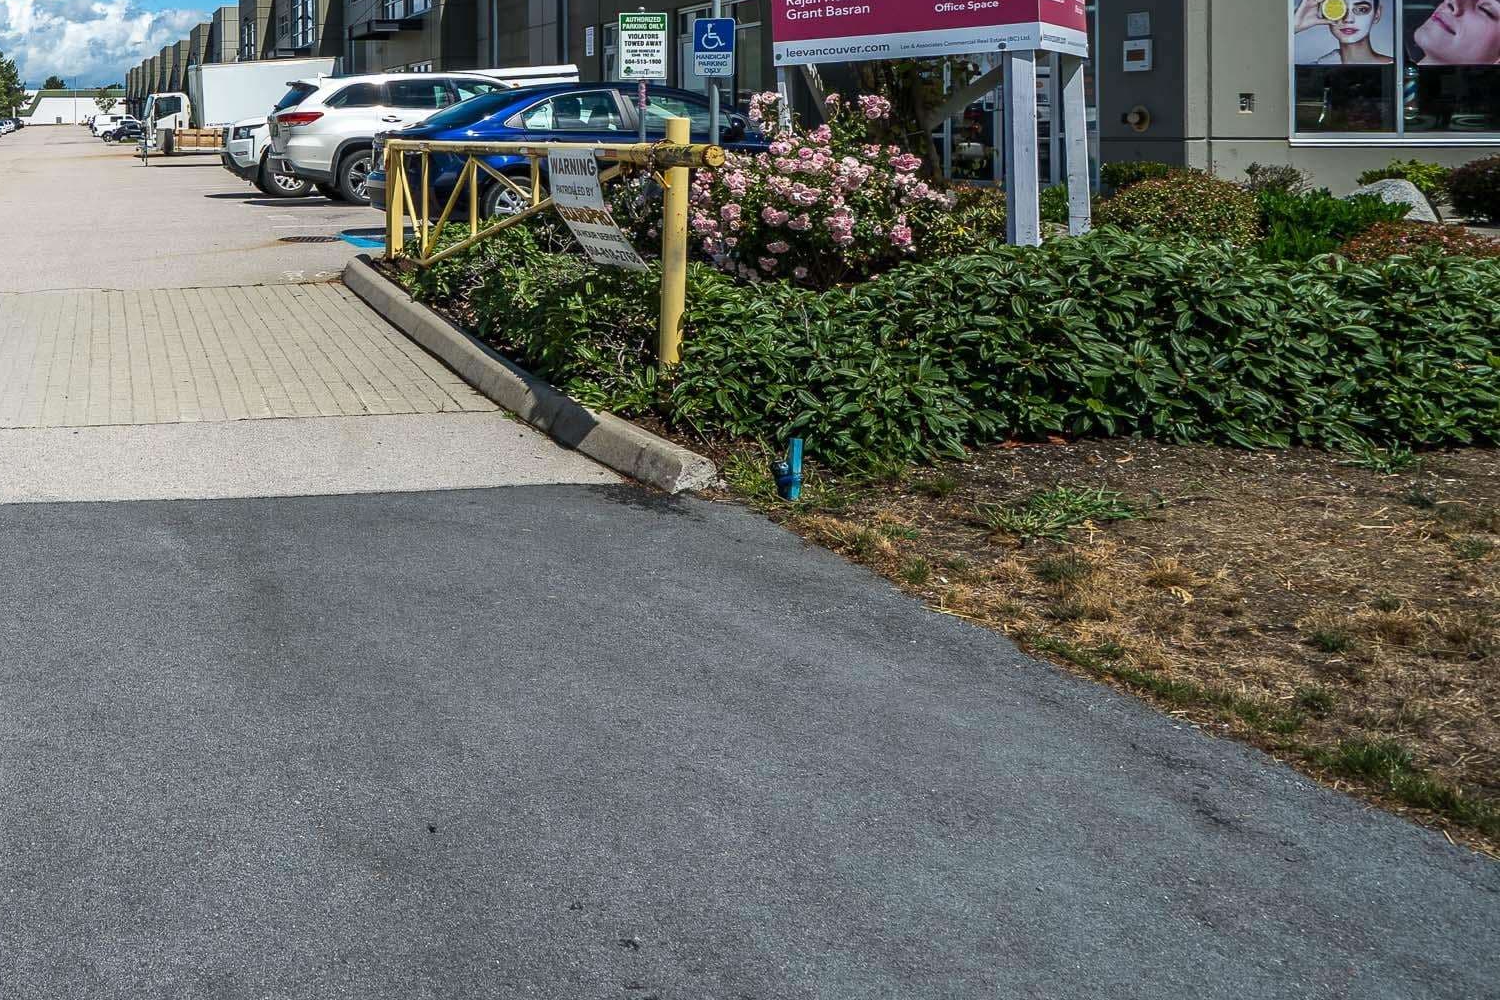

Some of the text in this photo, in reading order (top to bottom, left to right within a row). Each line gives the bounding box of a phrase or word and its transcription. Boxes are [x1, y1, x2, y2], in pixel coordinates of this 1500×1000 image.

[786, 5, 870, 20] Grant Basran
[935, 0, 998, 12] Office Space
[786, 41, 890, 58] leevancouver.com
[550, 158, 596, 176] WARNING
